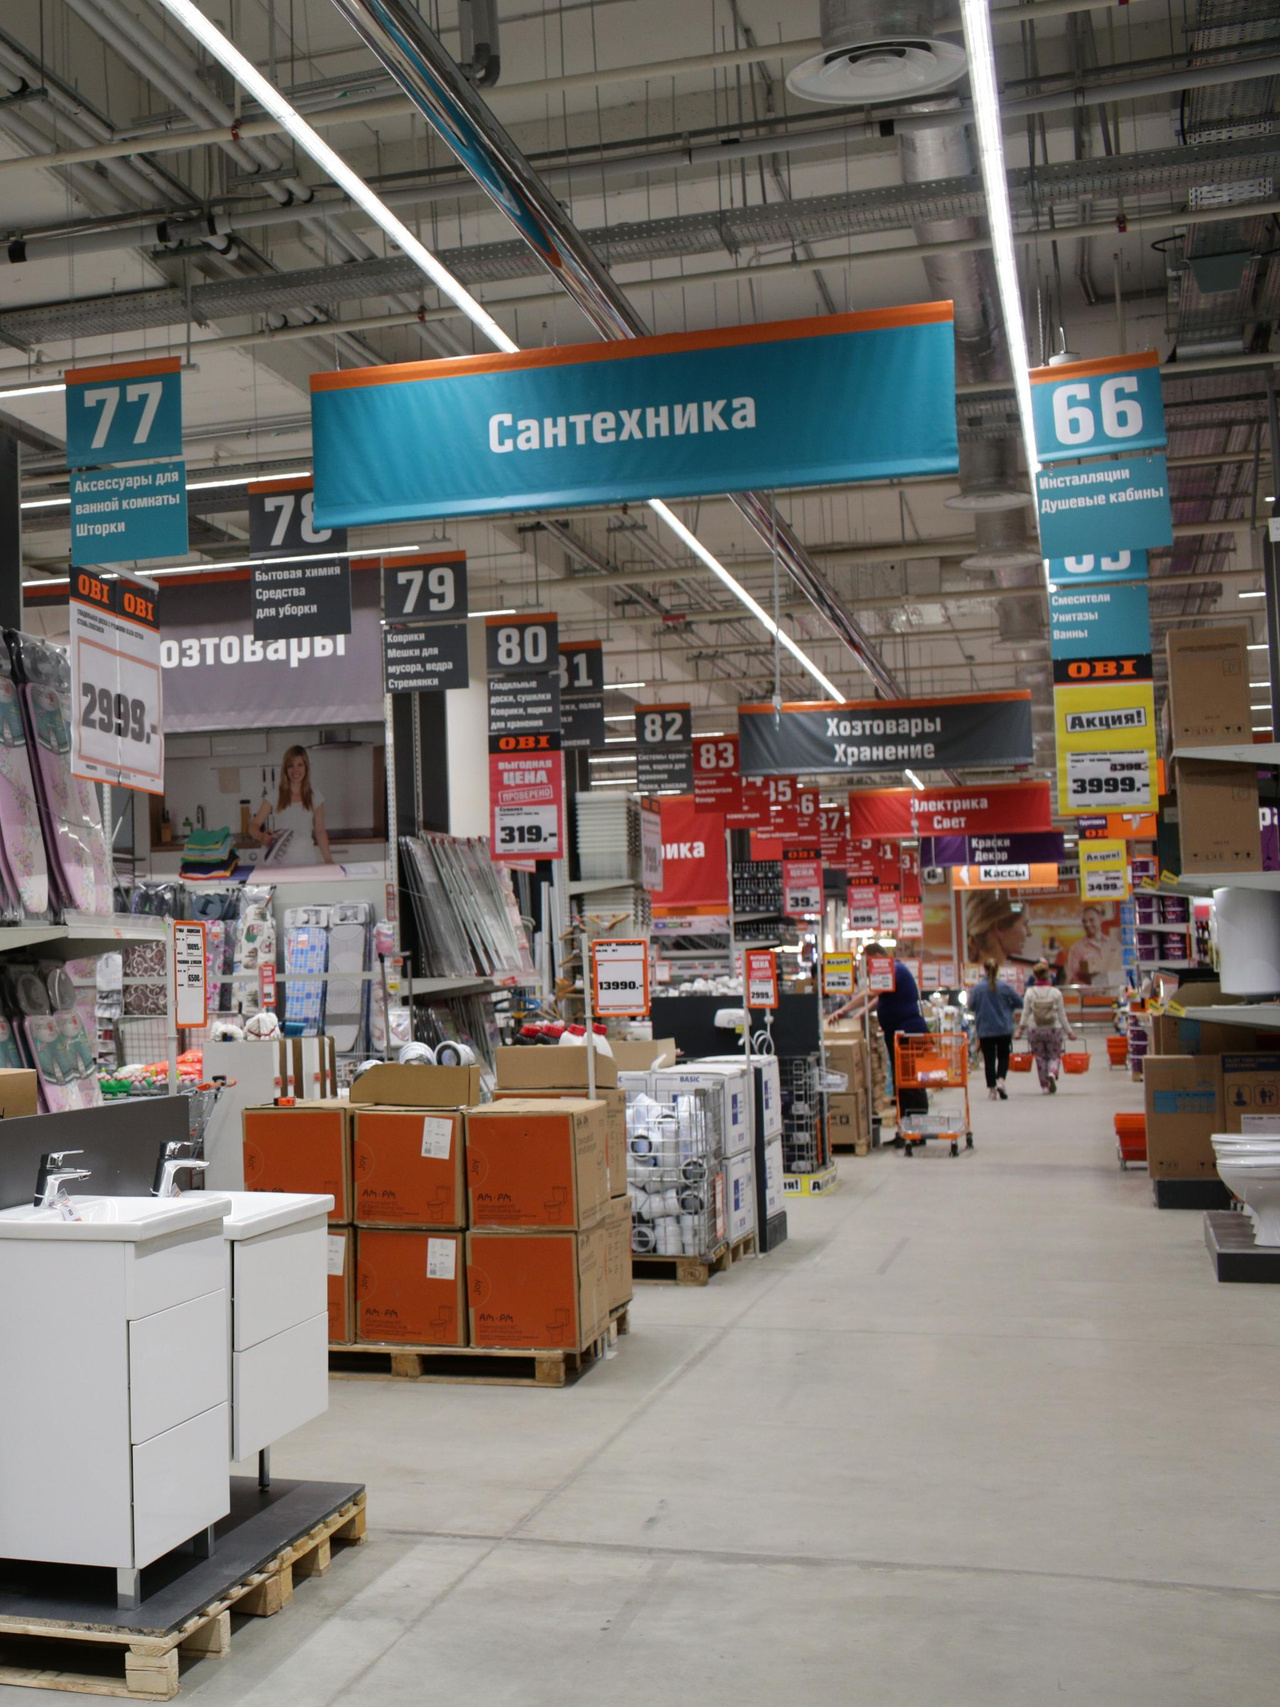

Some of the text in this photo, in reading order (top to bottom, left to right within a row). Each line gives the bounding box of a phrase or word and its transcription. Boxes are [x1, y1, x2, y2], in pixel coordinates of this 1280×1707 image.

[84, 381, 163, 449] 77
[1052, 376, 1144, 446] 66
[488, 395, 757, 454] Сантехника
[74, 471, 179, 493] Аксессуары для
[1039, 468, 1130, 490] Инсталляции
[75, 493, 180, 515] ванной комнаты
[1041, 487, 1164, 514] Душевые кабины
[75, 521, 126, 537] Шторки
[255, 565, 341, 582] Бытовая химия
[78, 574, 109, 604] OBI
[256, 586, 306, 600] Средства
[397, 567, 455, 614] 79
[124, 593, 154, 621] OBI
[1052, 592, 1111, 607] Смесители
[256, 603, 318, 619] для уборки
[1052, 611, 1098, 625] Унитазы
[387, 632, 425, 644] Коврики
[1053, 628, 1088, 640] Ванны
[160, 634, 346, 668] озтовары
[387, 646, 439, 659] Мешки для
[497, 625, 548, 665] 80
[388, 661, 453, 675] мусора, ведра
[1068, 659, 1137, 678] OBI
[388, 678, 439, 690] Стремянки
[490, 680, 537, 691] Гладильные
[490, 693, 551, 704] доски, сушилки
[490, 706, 526, 717] Коврики,
[527, 705, 553, 716] ящики
[490, 718, 544, 730] для хранения
[644, 713, 683, 742] 82
[826, 717, 941, 738] Хозтовары
[1070, 710, 1142, 730] Акция!
[499, 735, 550, 750] OBI
[700, 742, 735, 769] 83
[834, 742, 935, 766] Хранение
[498, 760, 552, 770] ВЫГОДНАЯ
[503, 770, 548, 786] ЦЕНА
[1072, 776, 1150, 794] 3999.-
[502, 789, 551, 801] ПРОВЕРЕНО
[911, 798, 988, 813] Электрика
[933, 816, 966, 829] Свет
[971, 838, 1010, 850] Краски
[974, 850, 1008, 863] Декор
[1086, 852, 1120, 862] Акция!
[984, 867, 1027, 879] Кассы
